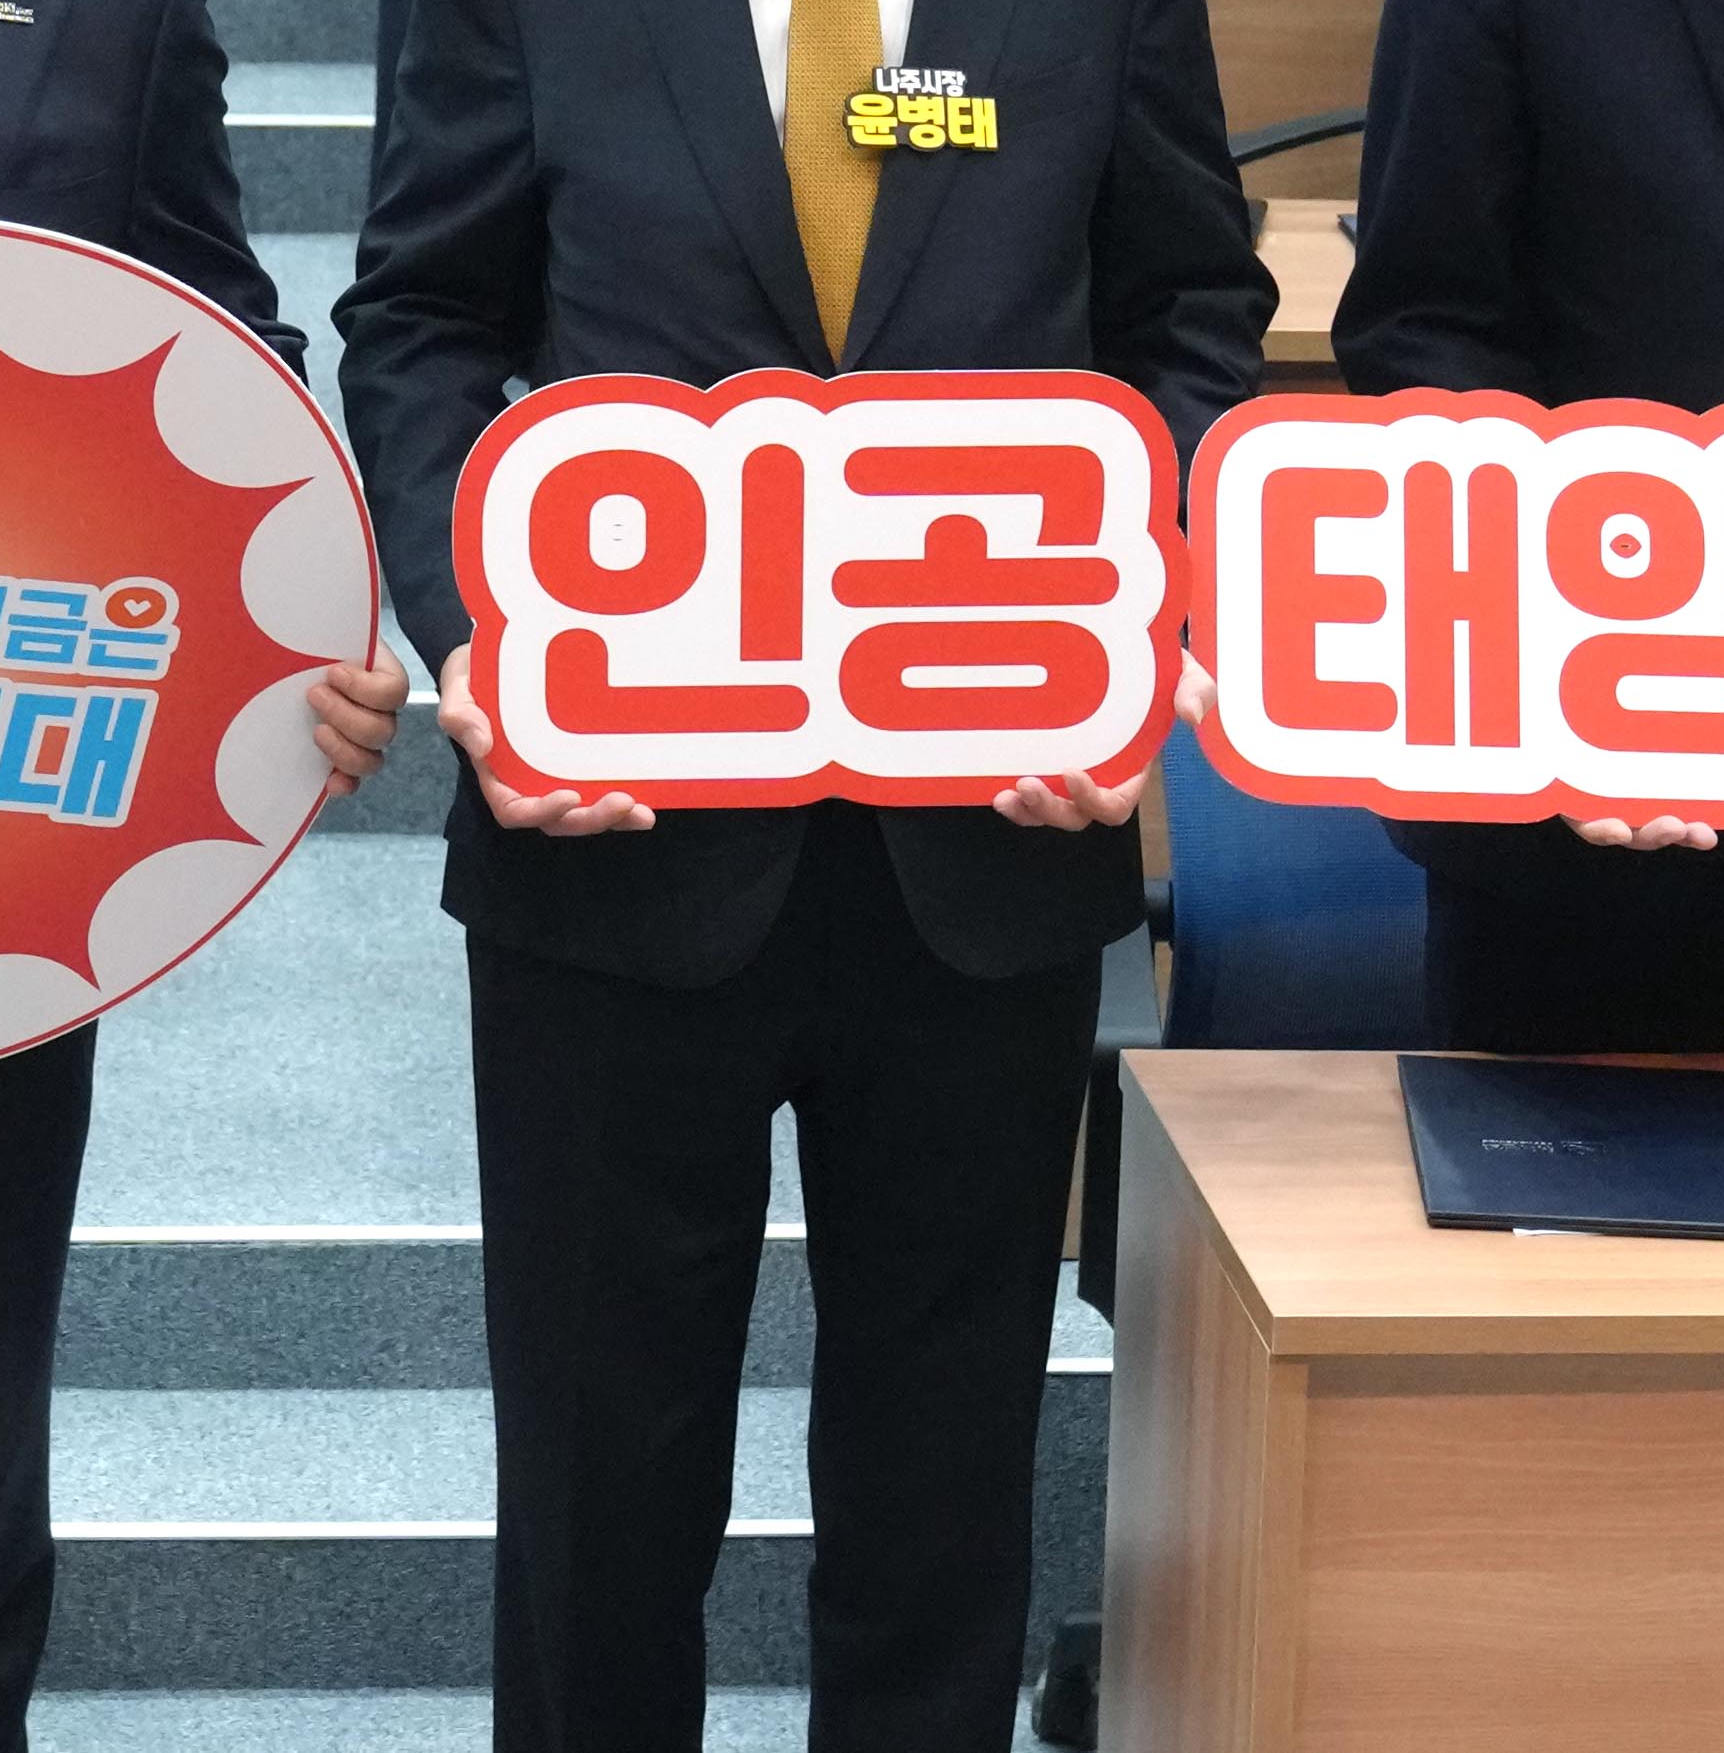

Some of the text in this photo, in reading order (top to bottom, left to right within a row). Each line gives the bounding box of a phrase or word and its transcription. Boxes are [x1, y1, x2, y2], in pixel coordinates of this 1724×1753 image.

[876, 69, 967, 97] 나주시장
[847, 93, 998, 148] 윤병태
[526, 441, 1123, 738] 인공
